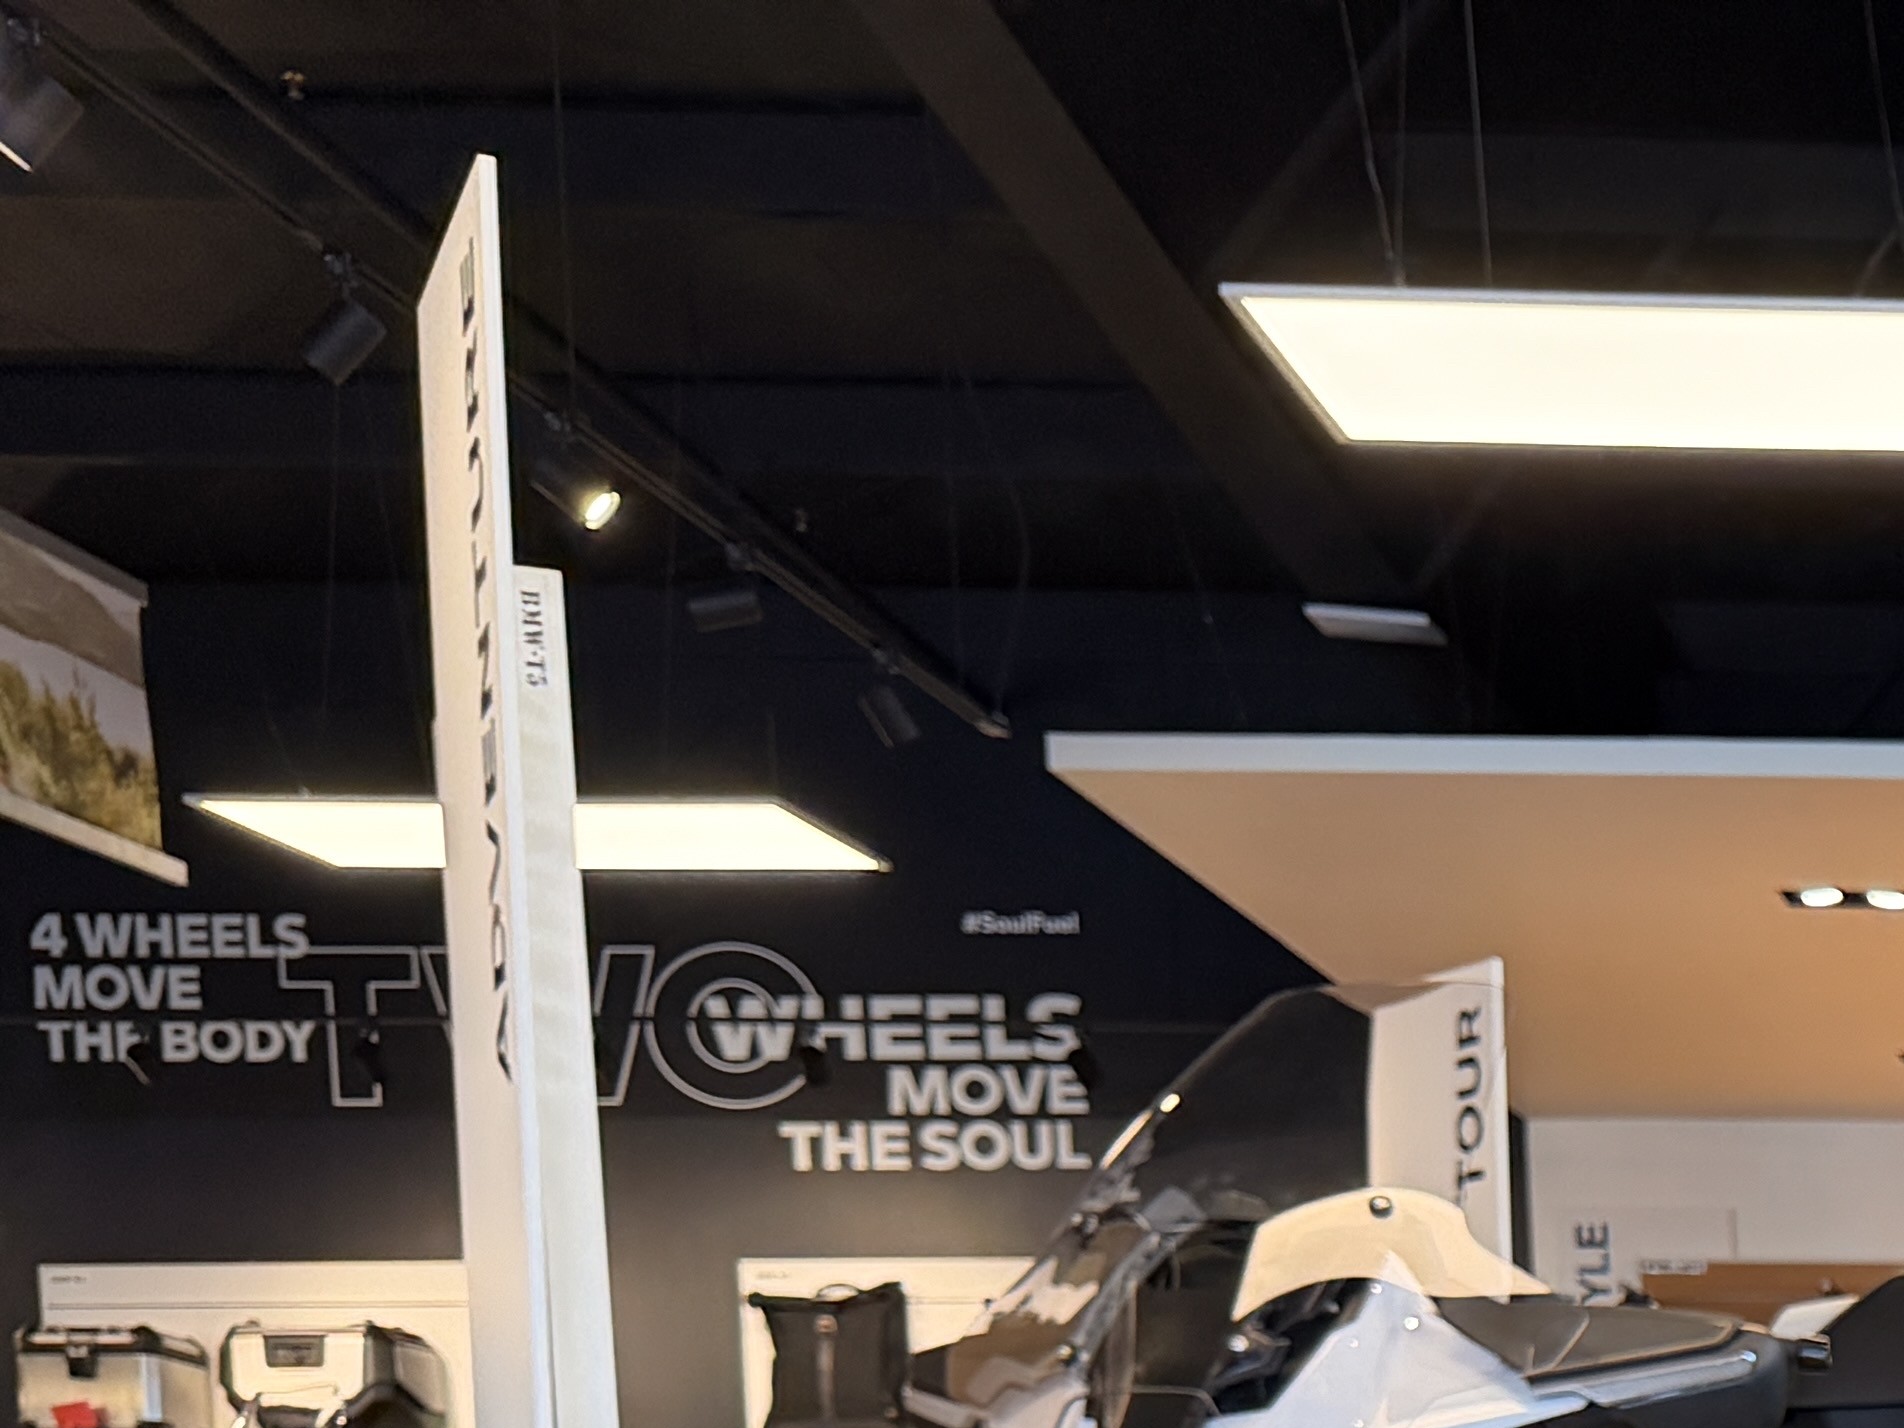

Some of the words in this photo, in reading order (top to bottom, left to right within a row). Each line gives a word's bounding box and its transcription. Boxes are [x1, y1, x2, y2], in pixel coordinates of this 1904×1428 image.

[29, 912, 68, 959] 4
[73, 912, 310, 960] WHEELS
[960, 909, 1081, 936] #SoulFuel
[33, 963, 203, 1011] MOVE
[160, 1019, 317, 1064] BODY
[703, 992, 1083, 1062] WHEELS
[886, 1063, 1091, 1117] MOVE
[1456, 1006, 1487, 1208] TOUR
[777, 1118, 913, 1172] THE
[917, 1117, 1093, 1172] SOUL
